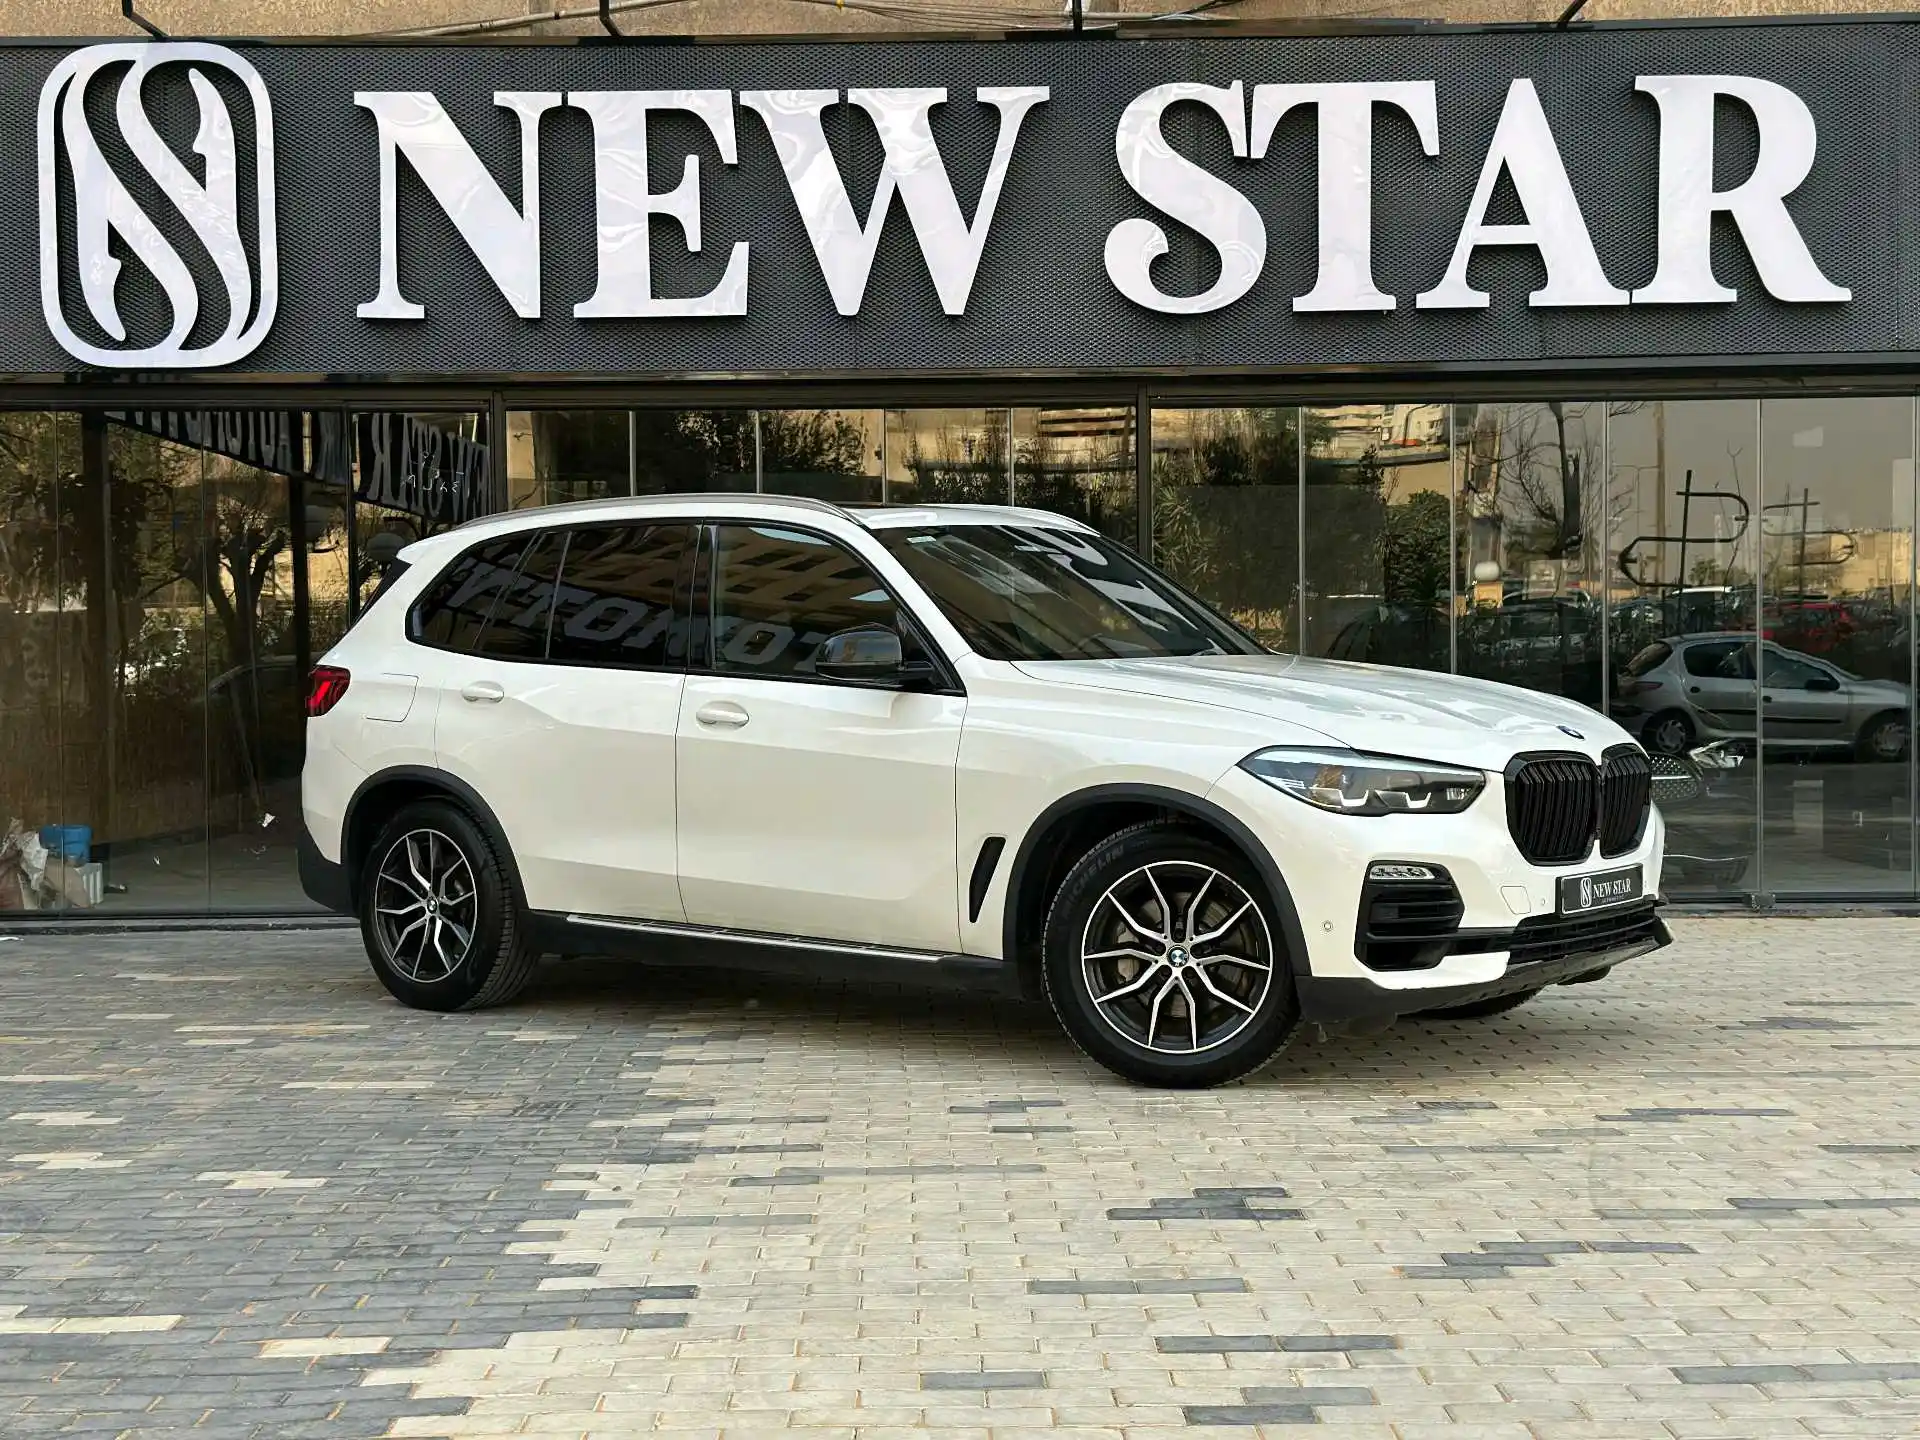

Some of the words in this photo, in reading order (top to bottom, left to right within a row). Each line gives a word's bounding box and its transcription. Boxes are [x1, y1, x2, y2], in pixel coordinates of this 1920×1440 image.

[353, 86, 1050, 320] NEW
[1103, 74, 1852, 315] STAR
[1593, 881, 1613, 899] NEW
[1613, 878, 1632, 895] STAR
